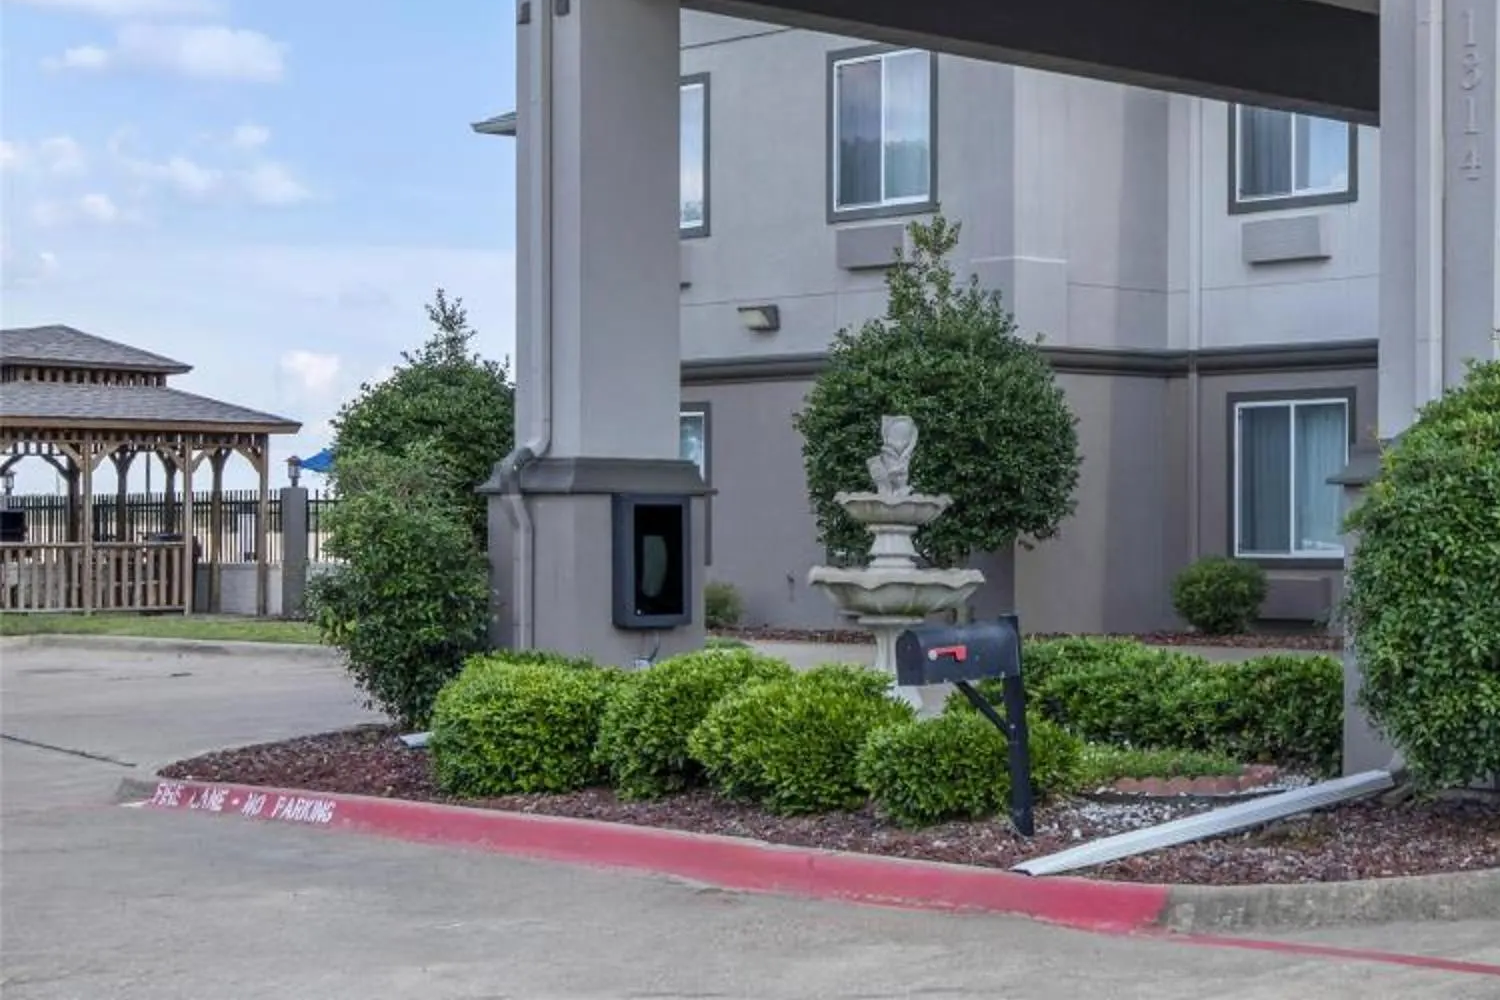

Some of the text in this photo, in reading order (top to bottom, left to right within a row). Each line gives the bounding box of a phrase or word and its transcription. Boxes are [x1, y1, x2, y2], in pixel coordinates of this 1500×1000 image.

[187, 787, 230, 812] LANE
[241, 792, 267, 817] NO
[271, 795, 337, 823] PARKING
